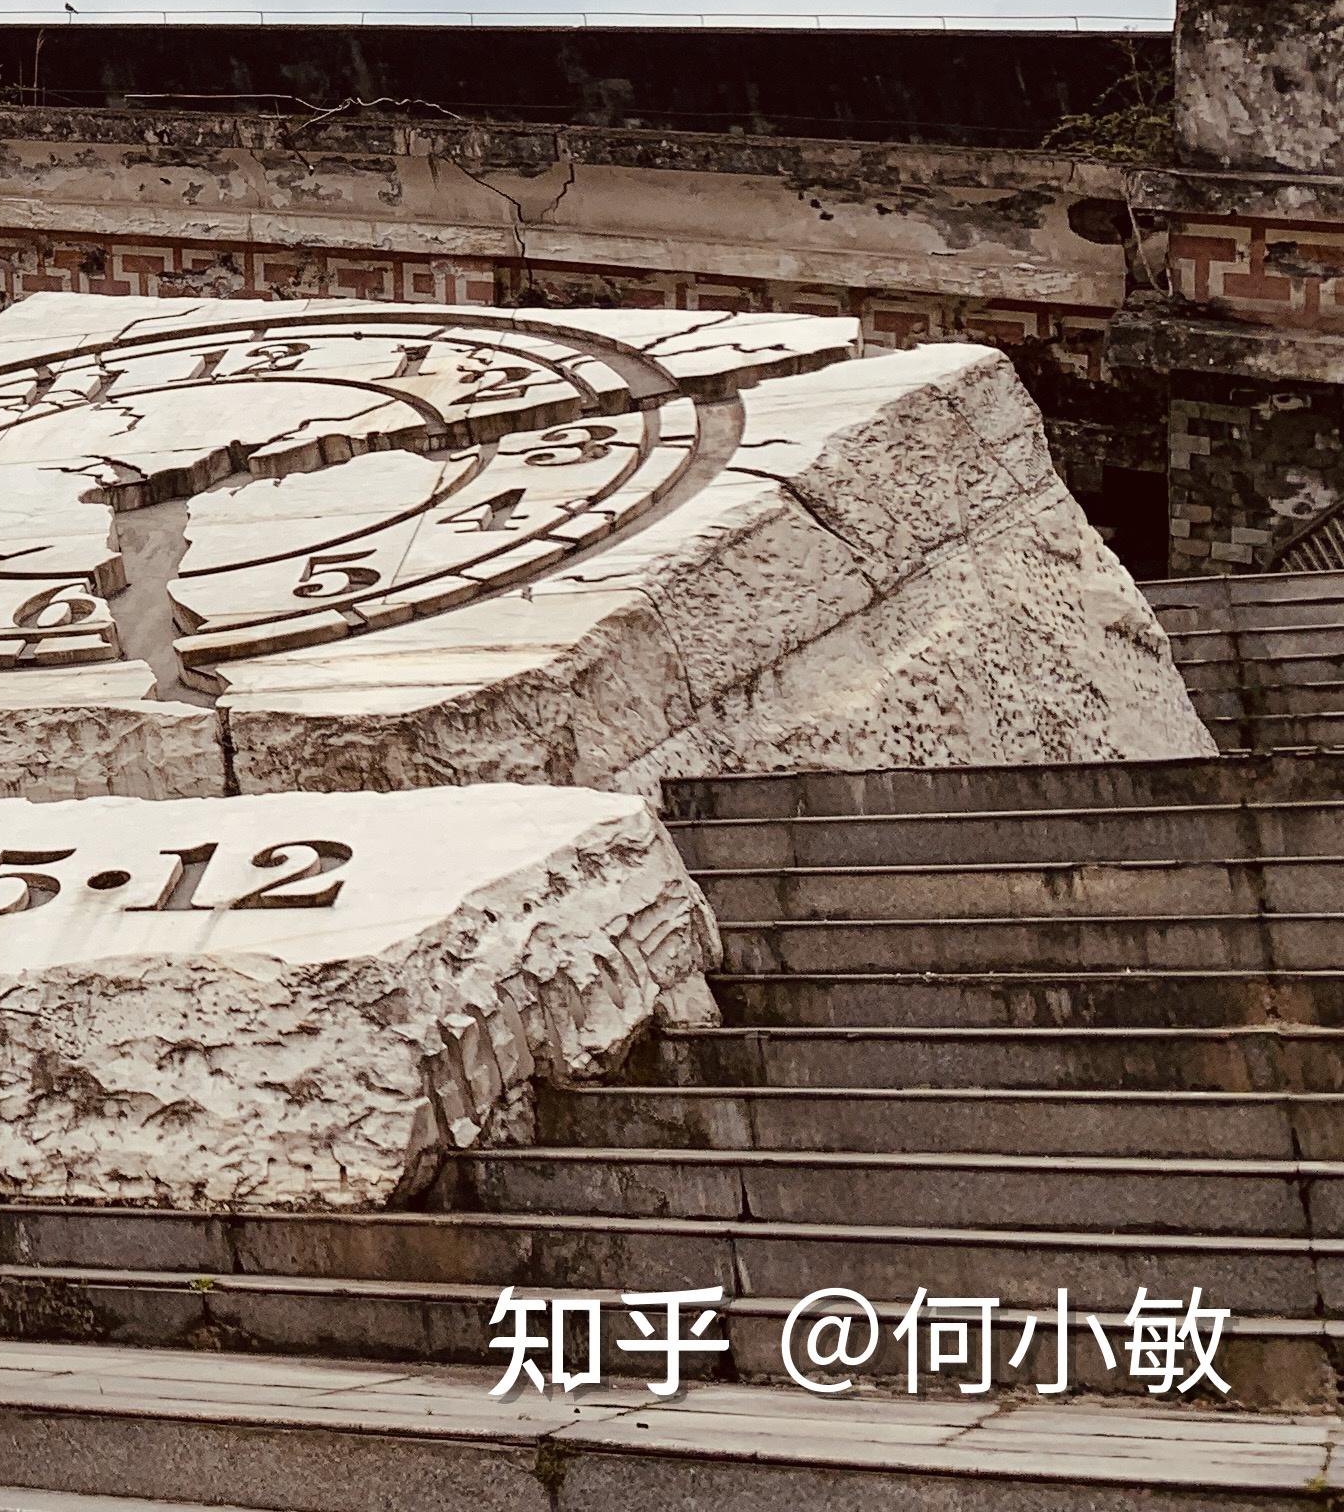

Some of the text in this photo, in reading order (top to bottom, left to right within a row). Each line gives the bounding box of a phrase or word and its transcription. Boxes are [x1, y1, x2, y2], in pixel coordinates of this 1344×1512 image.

[370, 343, 434, 381] 1
[524, 425, 618, 467] 3
[436, 487, 530, 534] 4
[292, 548, 382, 598] 5
[12, 582, 98, 629] 6
